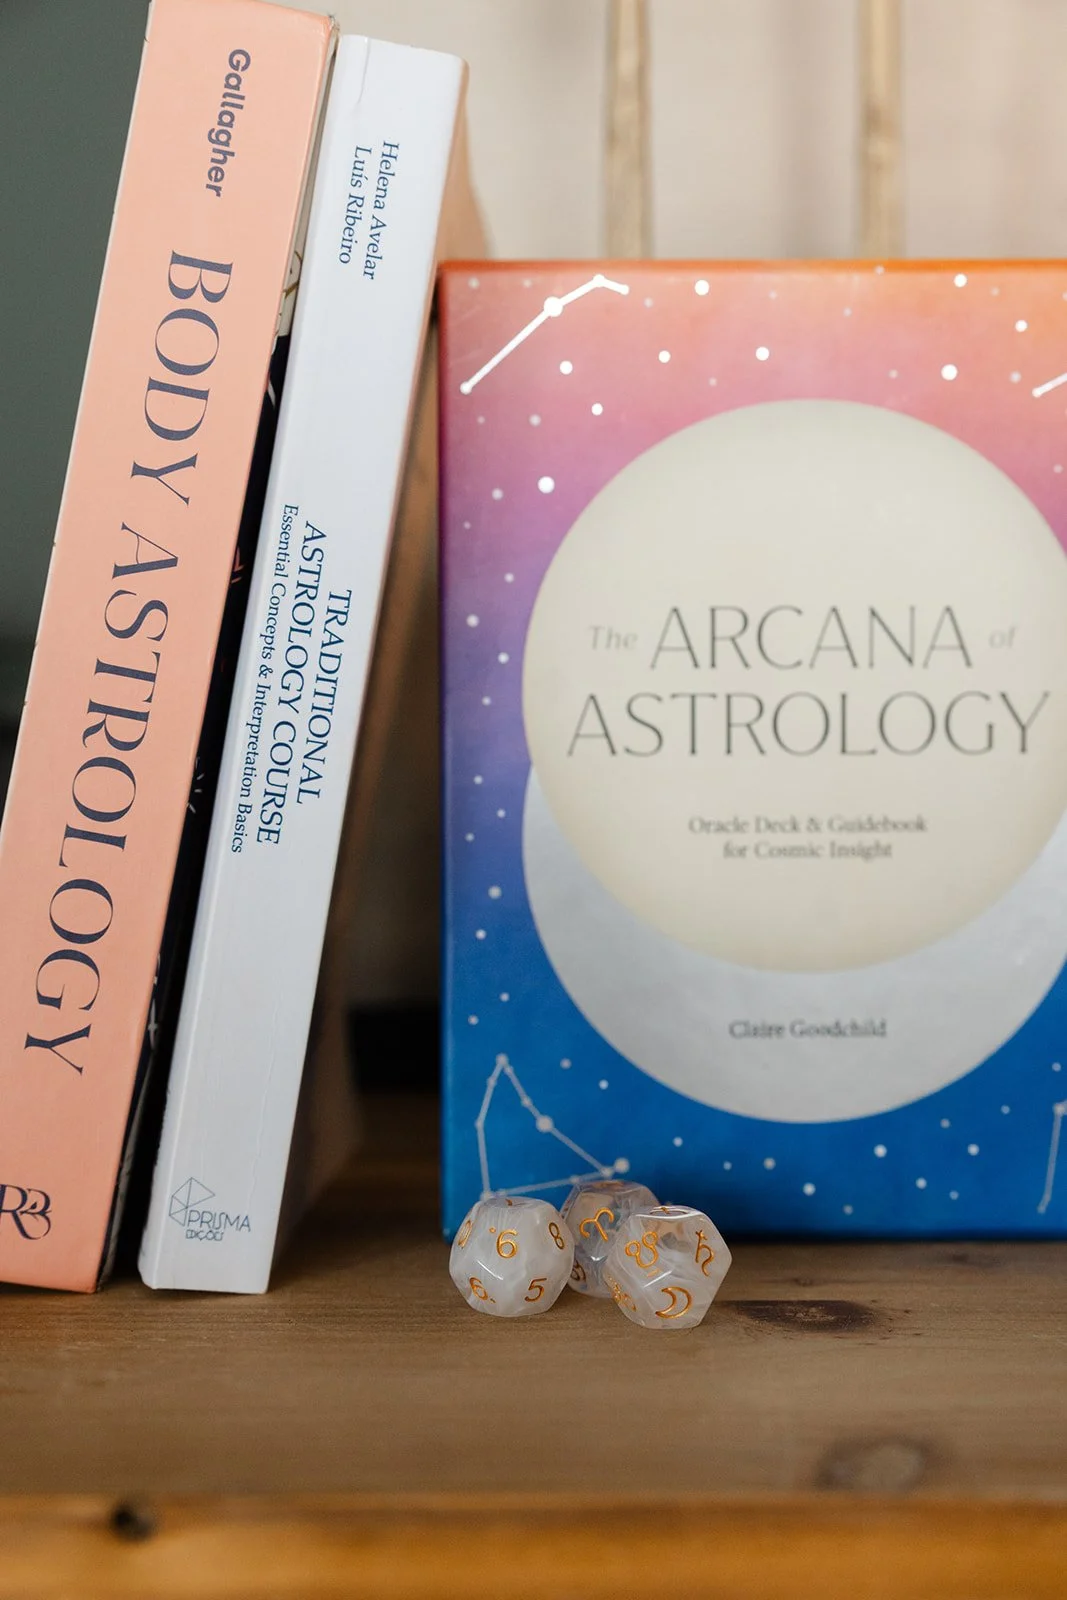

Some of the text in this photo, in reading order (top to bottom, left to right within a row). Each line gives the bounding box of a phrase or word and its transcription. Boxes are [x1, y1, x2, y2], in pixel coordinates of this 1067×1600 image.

[206, 48, 251, 197] Gallagher
[338, 145, 373, 265] Luís Ribeiro
[363, 140, 400, 280] Helena Avelar
[24, 250, 234, 1075] BODY ASTROLOGY
[231, 504, 299, 853] Essential Concepts & Interpretation Basics
[256, 520, 327, 845] ASTROLOGY COURSE
[588, 604, 1018, 670] The ARCANA of
[296, 589, 353, 805] TRADITIONAL
[567, 690, 1052, 757] ASTROLOGY
[688, 813, 928, 835] Oracle Deck & Guidebook
[722, 840, 892, 863] for Cosmic Insight
[728, 1017, 888, 1040] Claire Goodchild
[187, 1209, 251, 1233] PRISMA
[524, 1277, 548, 1303] 5
